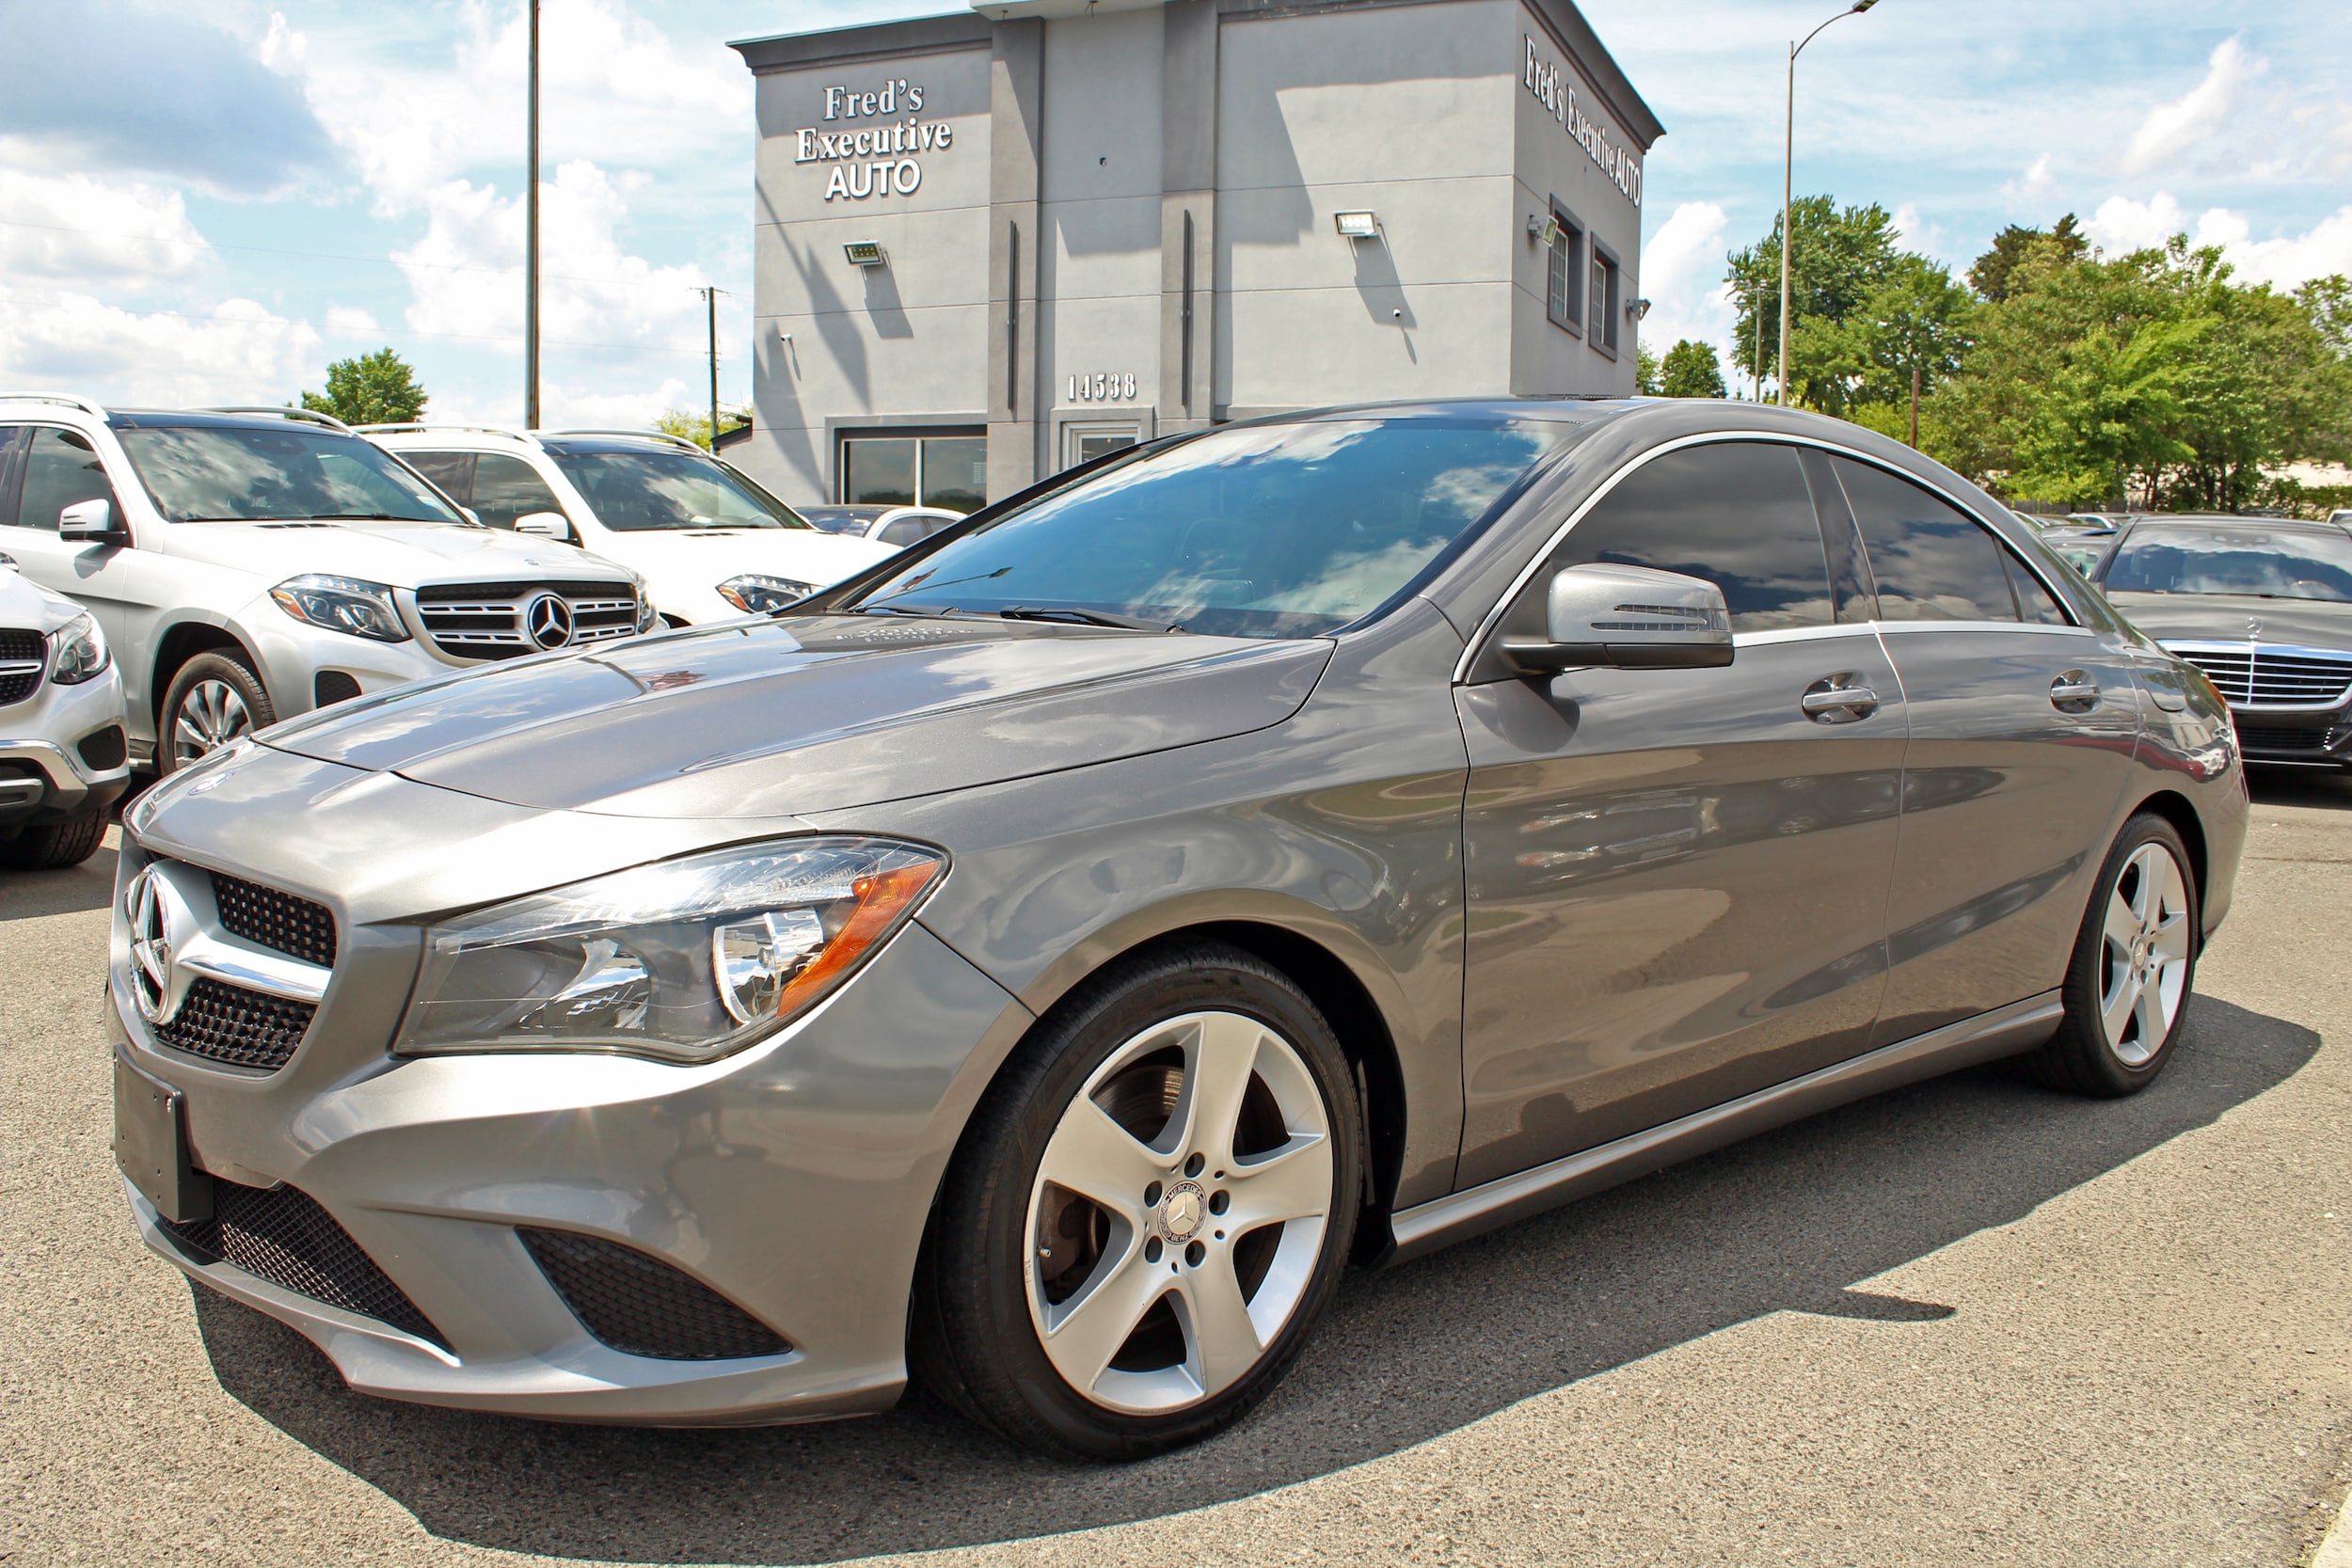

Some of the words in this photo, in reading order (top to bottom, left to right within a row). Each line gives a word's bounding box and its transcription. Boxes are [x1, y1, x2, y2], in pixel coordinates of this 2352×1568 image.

[822, 78, 924, 120] Fred's
[794, 117, 953, 164] Executive
[1524, 33, 1564, 122] Fred's
[1565, 83, 1614, 180] Executive
[1613, 146, 1641, 208] AUTO
[824, 158, 922, 200] AUTO
[1068, 372, 1136, 400] 14538
[1168, 1184, 1202, 1199] MERCEDES
